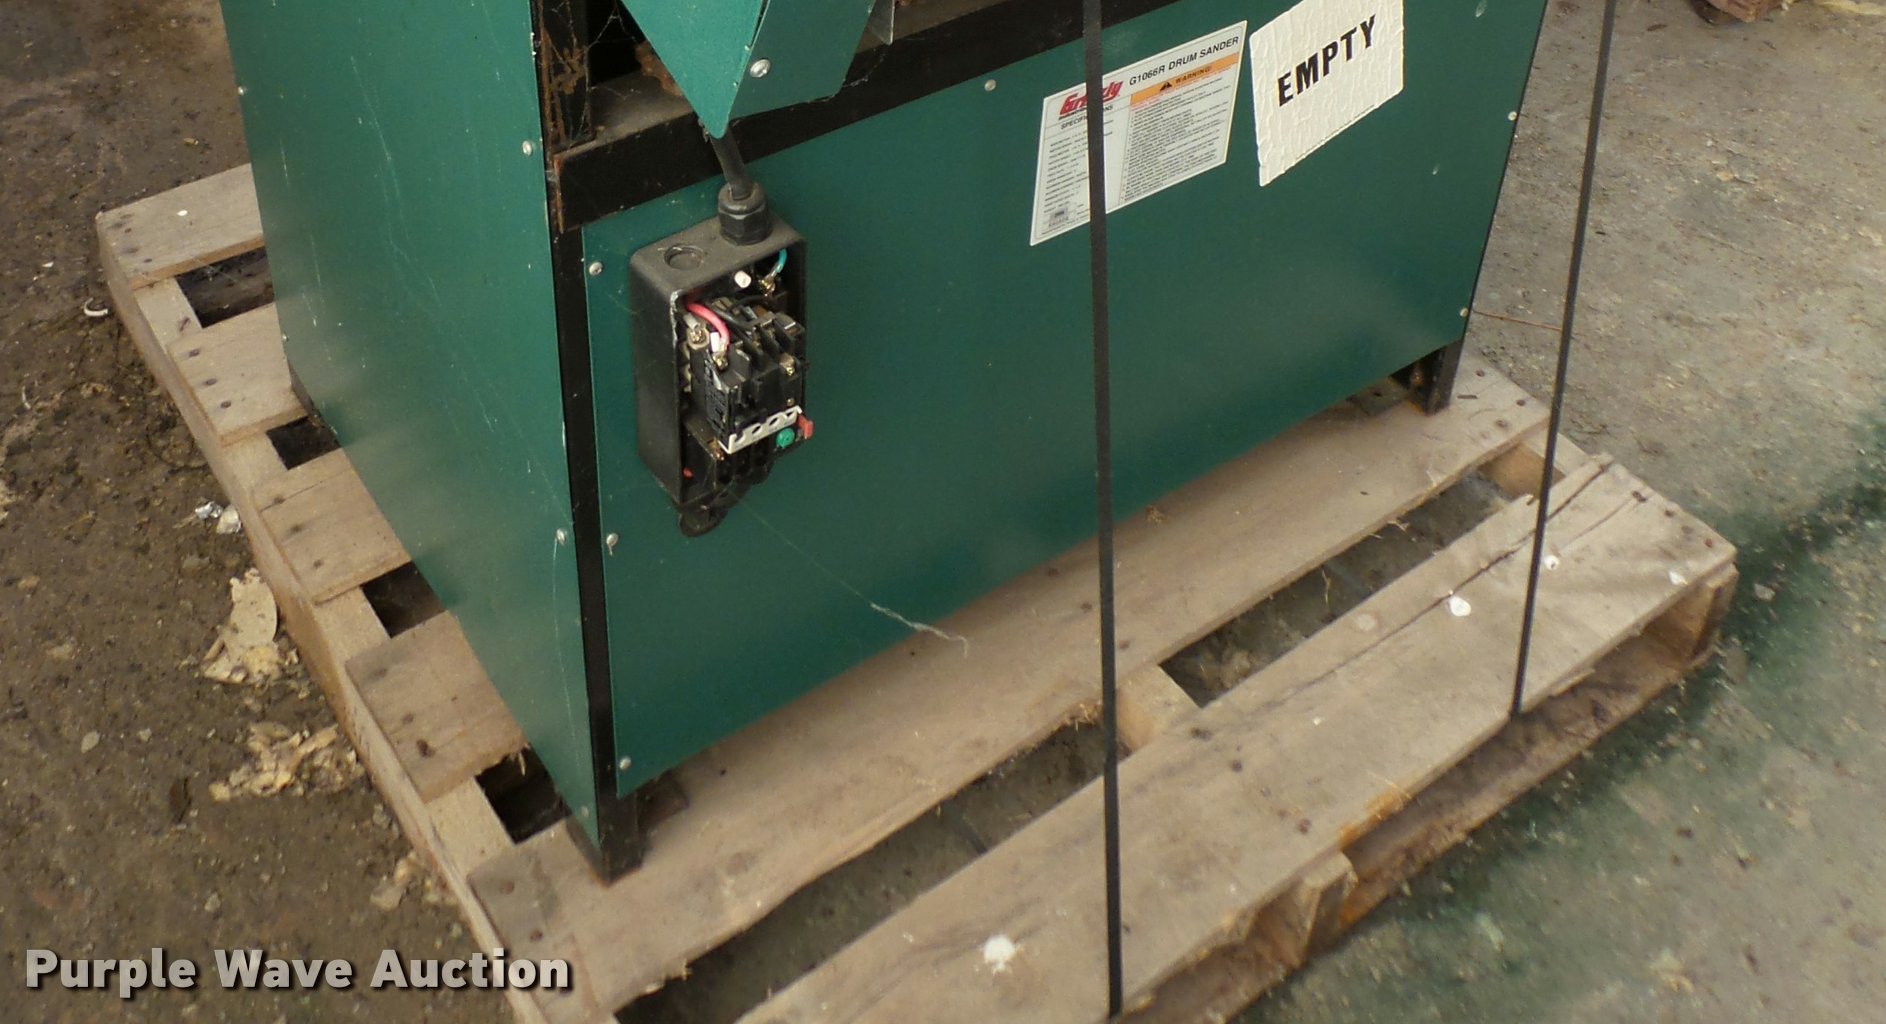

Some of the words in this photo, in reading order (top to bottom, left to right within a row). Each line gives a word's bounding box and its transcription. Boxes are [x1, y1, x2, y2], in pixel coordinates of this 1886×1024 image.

[1129, 65, 1166, 85] G1066R
[1168, 52, 1197, 70] DRUM
[1199, 36, 1239, 58] SANDER
[1277, 13, 1376, 108] EMPTY
